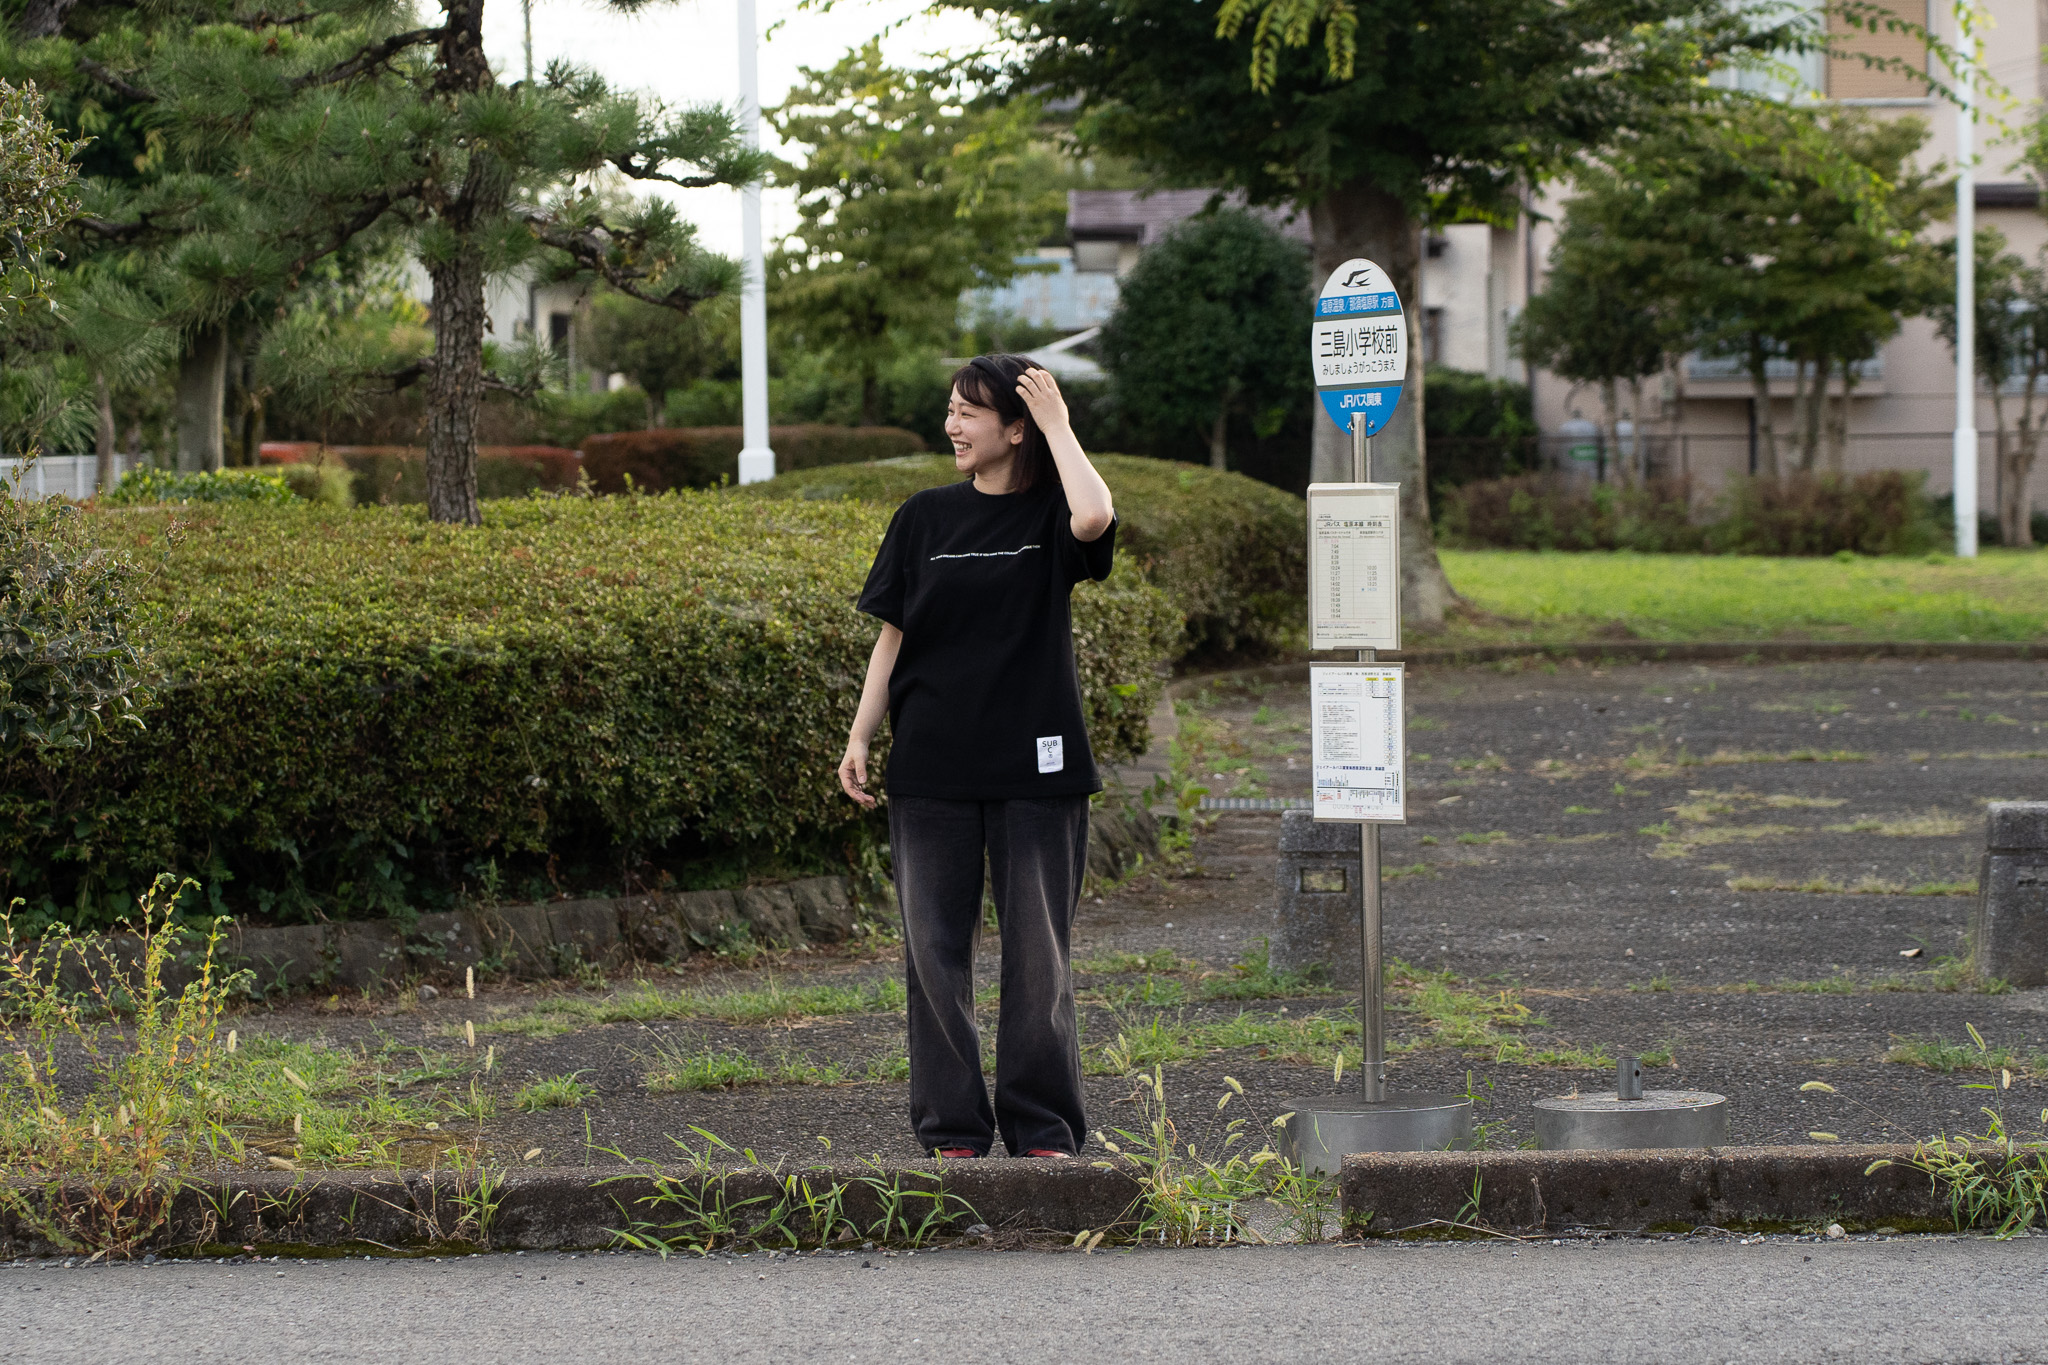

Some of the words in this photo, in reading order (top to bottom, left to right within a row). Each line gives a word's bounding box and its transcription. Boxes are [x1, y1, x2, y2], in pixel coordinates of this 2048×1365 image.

[1380, 296, 1395, 309] 方面
[1320, 325, 1398, 358] 三島小学校前
[1322, 359, 1396, 376] みしましょうがっこうまえ
[1340, 392, 1382, 408] JRバス関東
